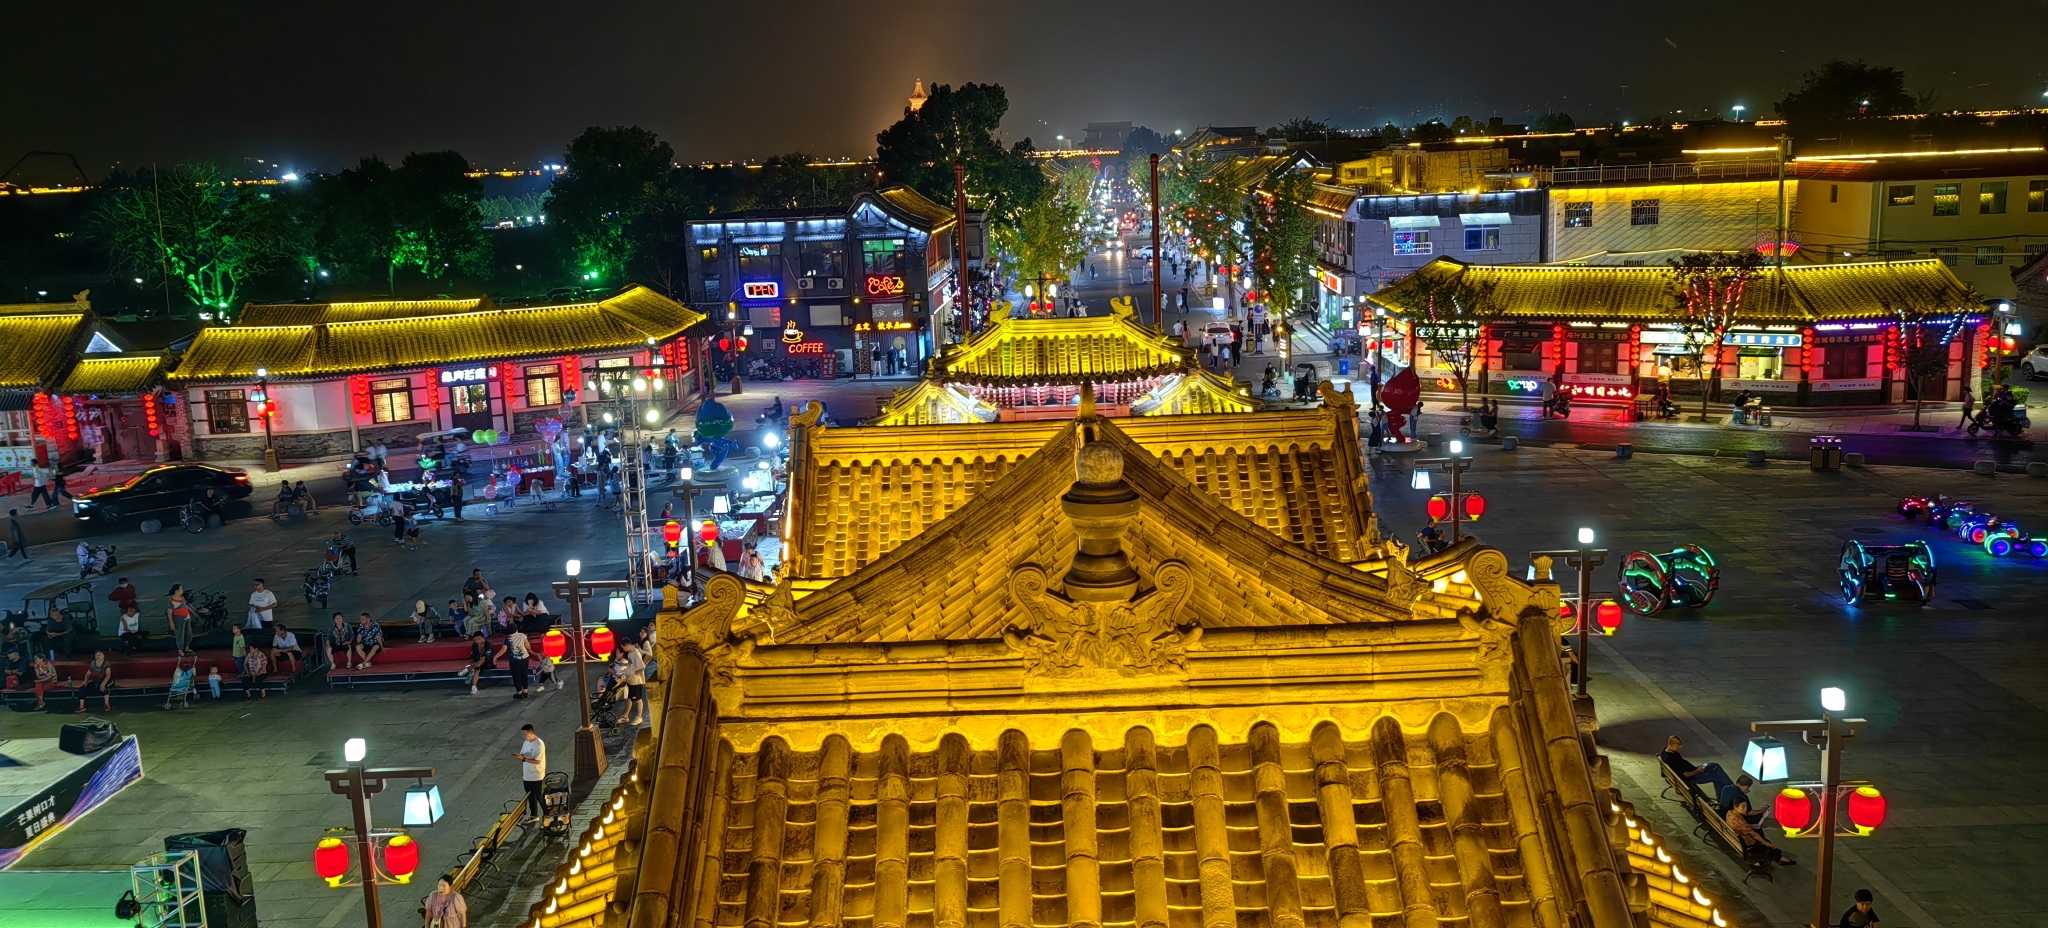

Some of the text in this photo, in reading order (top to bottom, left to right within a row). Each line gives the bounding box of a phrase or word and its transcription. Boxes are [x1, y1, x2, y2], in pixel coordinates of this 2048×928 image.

[746, 284, 776, 296] OPEN
[788, 342, 824, 354] COFFEE
[17, 794, 56, 827] 芒果树口才
[24, 811, 56, 840] 夏日盛典
